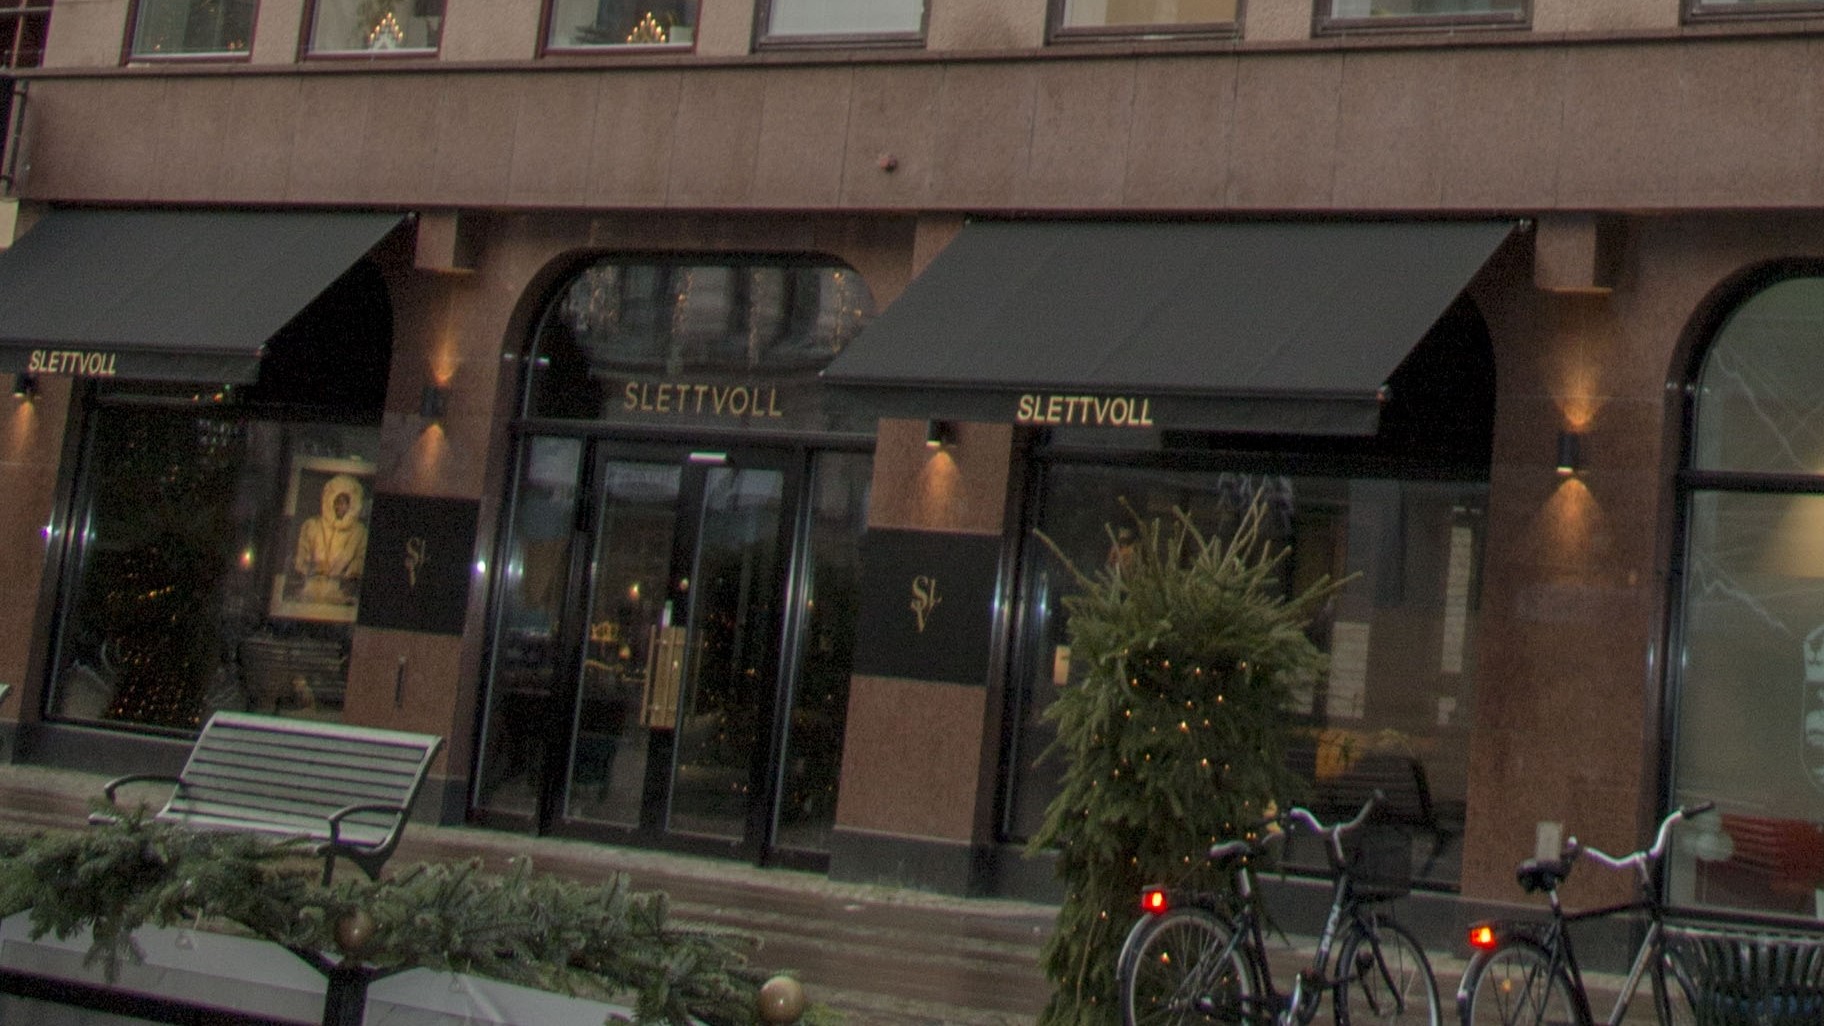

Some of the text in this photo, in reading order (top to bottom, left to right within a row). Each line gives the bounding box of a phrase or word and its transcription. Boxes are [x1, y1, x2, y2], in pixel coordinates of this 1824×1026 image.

[28, 350, 116, 374] SLETTVOLL
[624, 381, 783, 417] SLETTVOLL
[1017, 394, 1153, 425] SLETTVOLL
